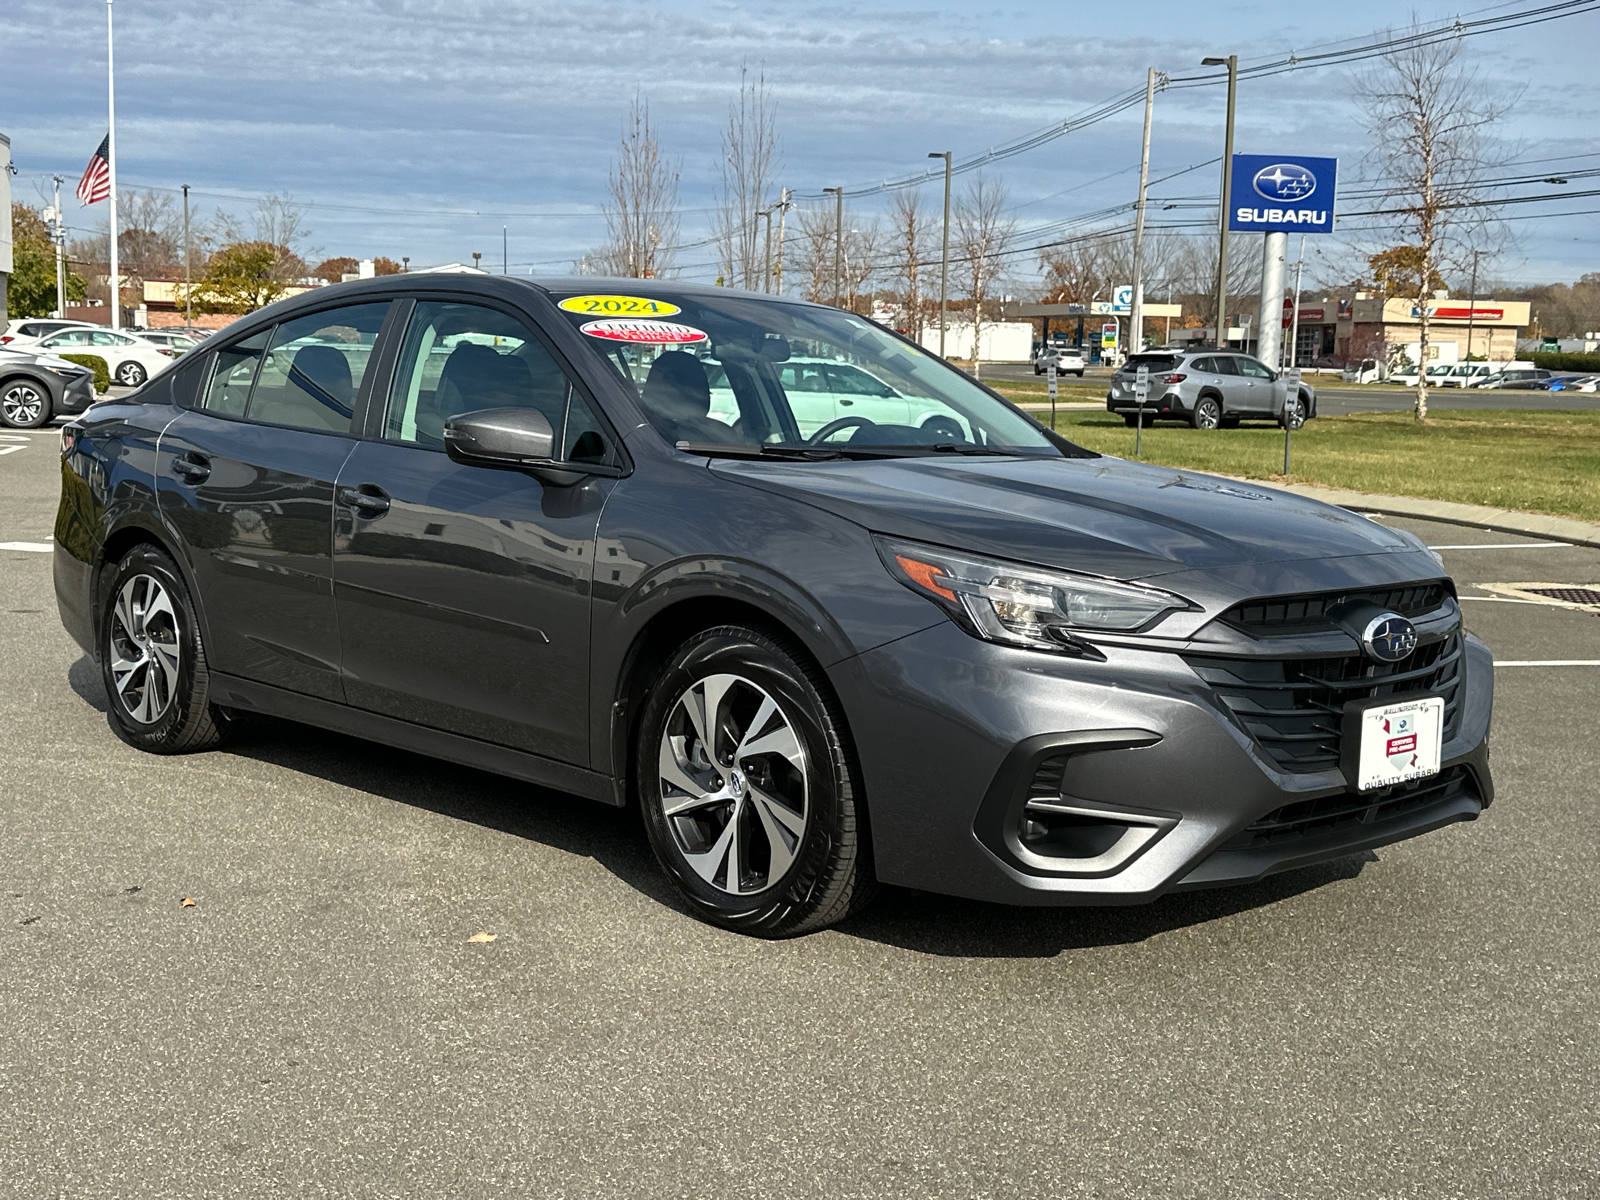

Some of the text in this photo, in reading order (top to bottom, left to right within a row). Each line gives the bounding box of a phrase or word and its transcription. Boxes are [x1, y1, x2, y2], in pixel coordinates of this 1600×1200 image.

[1237, 207, 1326, 225] SUBARU
[584, 300, 662, 313] 2024
[594, 323, 690, 333] CERTIFIED
[619, 332, 683, 341] VEHICLE
[1364, 767, 1438, 789] QUALITY SUBARU
